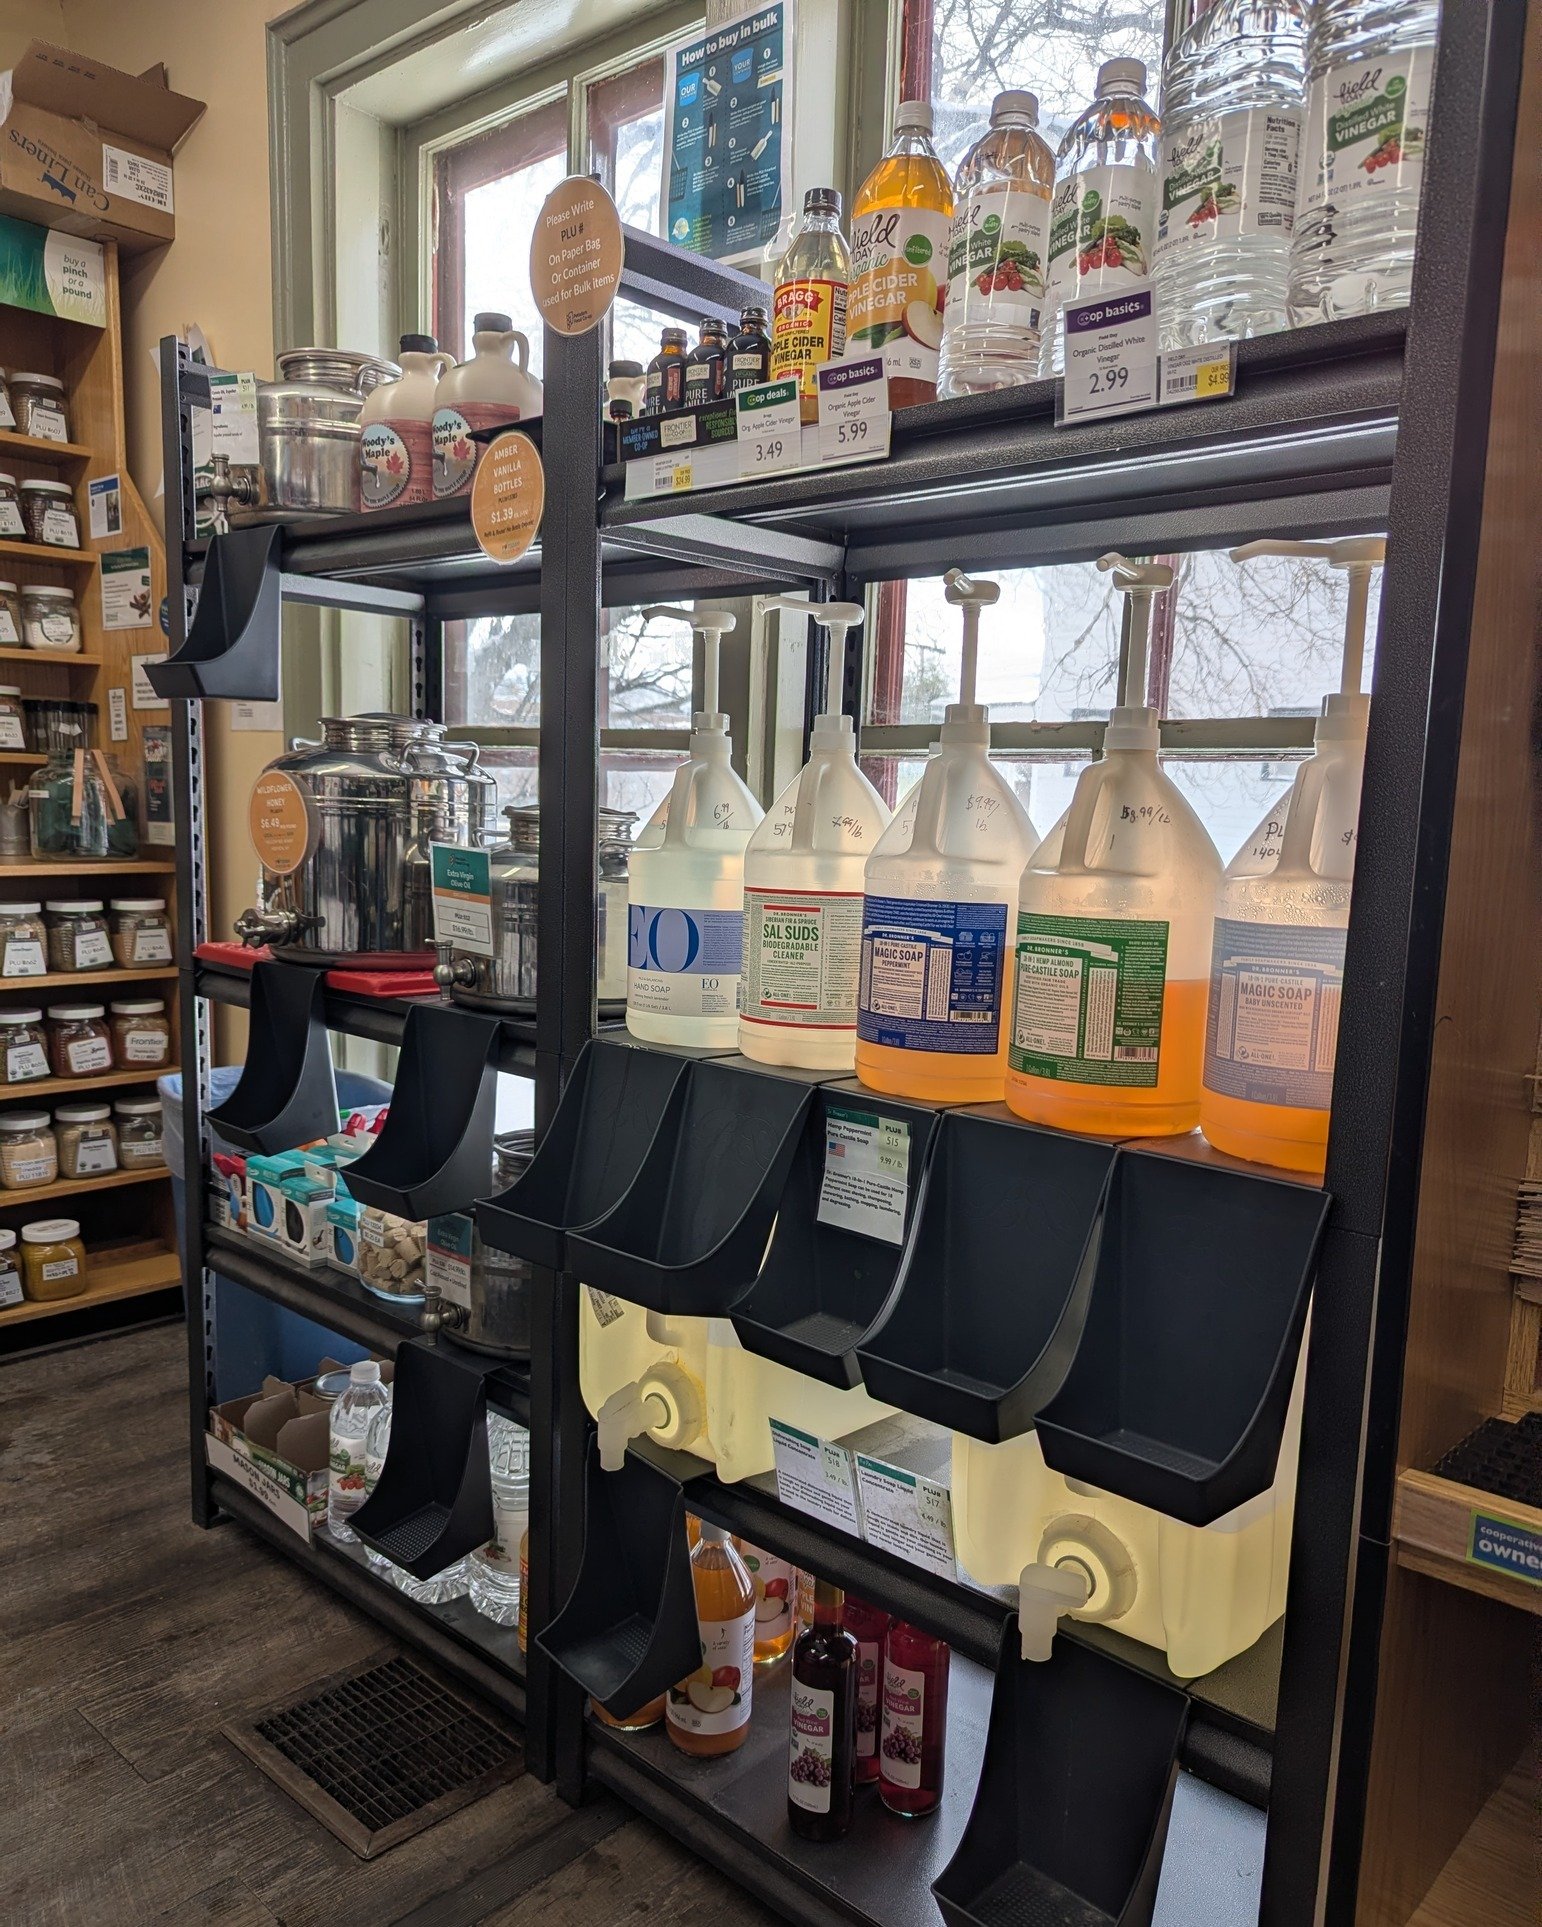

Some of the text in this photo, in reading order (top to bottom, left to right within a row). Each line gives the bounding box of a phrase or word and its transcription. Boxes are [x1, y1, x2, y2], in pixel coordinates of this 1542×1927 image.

[682, 12, 778, 66] How to buy in bulk
[734, 59, 751, 70] YOUR
[681, 83, 696, 95] OUR
[1266, 116, 1296, 128] Nutrition
[1266, 124, 1285, 133] Facts
[1335, 110, 1396, 143] VINEGAR
[9, 128, 69, 186] Liners
[75, 178, 110, 211] Can
[546, 200, 594, 228] Please Write
[561, 223, 584, 242] PLU #
[549, 238, 601, 266] On Paper Bag
[64, 255, 79, 268] buy
[63, 266, 88, 279] pinch
[552, 258, 601, 284] Or Container
[872, 273, 918, 292] CIDER
[63, 286, 92, 299] pound
[542, 273, 615, 307] used for Bulk items
[777, 291, 814, 308] BRAGG
[850, 291, 906, 319] VINEGAR
[778, 321, 809, 332] ORGANIC
[792, 336, 824, 348] CIDER
[1073, 336, 1145, 358] Organic Distilled White
[774, 349, 812, 365] VINEGAR
[1097, 354, 1120, 363] Vinegar
[1089, 367, 1128, 394] 2.99
[686, 389, 707, 400] PURE
[828, 397, 876, 411] Organic Apple Cider
[843, 410, 860, 418] Vinegar
[665, 421, 692, 432] FRONTIER
[838, 422, 867, 443] 5.99
[435, 434, 457, 445] Maple
[494, 445, 518, 461] AMBER
[634, 442, 648, 452] CO-OP
[756, 441, 782, 461] 3.49
[365, 449, 390, 459] Maple
[493, 460, 521, 478] VANILLA
[494, 477, 523, 494] BOTTLES
[491, 507, 513, 523] $1.39
[257, 784, 292, 794] WILDFLOWER
[261, 818, 280, 828] $6.49
[460, 872, 474, 881] Virgin
[628, 903, 700, 973] EO
[763, 924, 819, 941] SAL SUDS
[763, 940, 819, 952] BIODEGRADABLE
[1035, 946, 1069, 955] BRONNER'S
[773, 951, 804, 960] CLEANER
[875, 947, 923, 962] MAGIC SOAP
[882, 960, 910, 969] PEPPERMINT
[1036, 956, 1074, 968] HEMP ALMOND
[1021, 963, 1079, 979] PURE-CASTILE SOAP
[634, 983, 649, 991] HAND
[702, 978, 719, 989] EO
[1264, 977, 1303, 986] PURE-CASTILE
[1241, 982, 1312, 1001] MAGIC SOAP
[1245, 998, 1303, 1010] BABY UNSCENTED
[131, 1038, 164, 1046] Frontier
[843, 1125, 872, 1137] Peppermint
[857, 1137, 869, 1145] Soap
[887, 1137, 898, 1147] 515
[880, 1156, 891, 1164] 9.99
[824, 1183, 840, 1191] different
[825, 1176, 847, 1186] Peppermint
[892, 1187, 904, 1195] Hemp
[774, 1438, 816, 1460] Liquid Concentrate
[827, 1457, 840, 1467] 518
[233, 1453, 260, 1482] MASON
[262, 1479, 280, 1499] JARS
[861, 1470, 913, 1494] Laundry Soap Liquid
[862, 1477, 894, 1493] Concentrate
[926, 1497, 939, 1507] 517
[1480, 1526, 1542, 1551] cooperativ
[1478, 1539, 1542, 1570] owne
[886, 1697, 915, 1712] VINEGAR
[794, 1718, 824, 1733] VINEGAR
